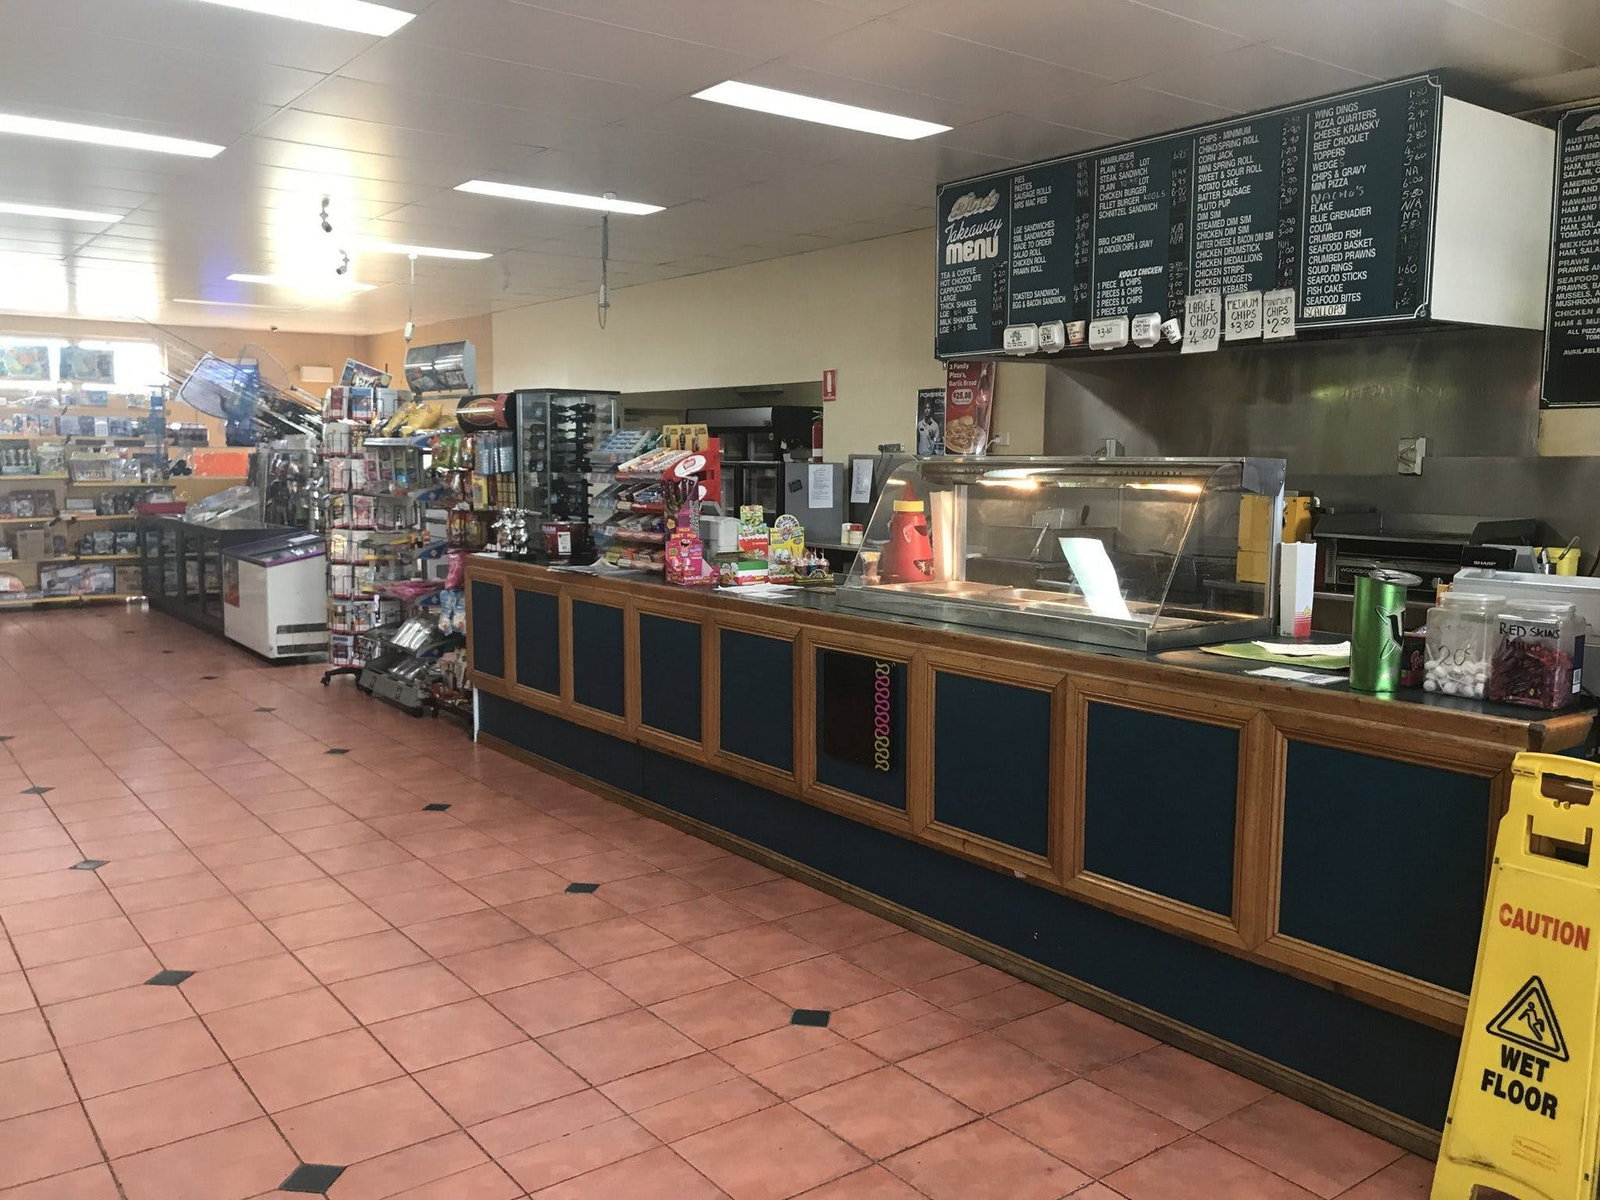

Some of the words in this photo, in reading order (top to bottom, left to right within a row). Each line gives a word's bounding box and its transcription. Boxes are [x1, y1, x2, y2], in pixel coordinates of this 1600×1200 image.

[1315, 108, 1333, 119] WING
[1336, 102, 1358, 113] DINGS
[1315, 118, 1334, 129] PIZZA
[1337, 108, 1376, 124] QUARTERS
[1200, 134, 1217, 144] CHIPS
[1223, 126, 1251, 139] MINIMUM
[1314, 128, 1340, 140] CHEESE
[1343, 119, 1380, 134] KRANSKY
[1199, 144, 1218, 154] CHIKO
[1219, 139, 1241, 149] SPRING
[1242, 135, 1259, 145] ROLL
[1314, 139, 1331, 151] BEEF
[1334, 132, 1370, 147] CROQUET
[1101, 152, 1134, 165] HAMBURGER
[1199, 155, 1216, 164] CORN
[1218, 150, 1233, 159] JACK
[1313, 147, 1345, 160] TOPPERS
[1213, 159, 1235, 170] SPRING
[1238, 156, 1254, 165] ROLL
[1100, 166, 1115, 174] PLAIN
[1100, 174, 1117, 184] STEAK
[1120, 168, 1148, 179] SANDWICH
[1198, 173, 1218, 183] SWEET
[1227, 168, 1244, 177] SOUR
[1246, 164, 1262, 173] ROLL
[1312, 170, 1332, 182] CHIPS
[1342, 165, 1366, 176] GRAVY
[1014, 182, 1032, 192] PASTIES
[1198, 182, 1220, 192] POTATO
[1222, 178, 1238, 188] CAKE
[1328, 178, 1348, 188] PIZZA
[1014, 187, 1035, 200] SAUSAGE
[1036, 186, 1052, 194] ROLLS
[1100, 192, 1123, 201] CHICKEN
[1124, 186, 1146, 196] BURGER
[1198, 192, 1220, 202] BATTER
[1222, 185, 1251, 198] SAUSAGE
[1100, 202, 1116, 210] FILLET
[1117, 197, 1139, 207] BURGER
[1198, 202, 1216, 212] PLUTO
[1218, 199, 1230, 208] PUP
[1311, 201, 1333, 214] FLAKE
[1099, 209, 1126, 219] SCHNITZEL
[1128, 202, 1158, 214] SANDWICH
[1310, 213, 1328, 224] BLUE
[1330, 206, 1372, 221] GRENADIER
[1197, 219, 1225, 231] STEAMED
[1227, 216, 1238, 225] DIM
[1560, 214, 1592, 224] ITALIAN
[945, 218, 1002, 244] Takeaway
[1024, 220, 1055, 233] SANDWICHES
[1309, 223, 1332, 234] COUTA
[1024, 229, 1055, 241] SANDWICHES
[1111, 233, 1135, 244] CHICKEN
[1197, 229, 1222, 240] CHICKEN
[1225, 227, 1236, 236] DIM
[1308, 231, 1343, 244] CRUMBED
[1345, 229, 1362, 239] FISH
[1560, 229, 1590, 239] TOMATO
[1036, 238, 1052, 247] ORDER
[1197, 241, 1213, 250] BATTER
[1214, 238, 1231, 247] CHEESE
[1238, 235, 1254, 243] BACON
[1308, 243, 1342, 255] SEAFOOD
[1344, 238, 1373, 248] BASKET
[1560, 239, 1599, 249] MEXICAN
[946, 236, 998, 265] MENU
[1013, 251, 1028, 259] SALAD
[1104, 245, 1121, 254] CHICKEN
[1196, 249, 1222, 259] CHICKEN
[1224, 244, 1260, 255] DRUMSTICK
[1308, 252, 1342, 264] CRUMBED
[1345, 248, 1376, 260] PRAWNS
[1013, 258, 1033, 267] CHICKEN
[1196, 258, 1222, 268] CHICKEN
[1224, 253, 1262, 265] MEDALLIONS
[1558, 258, 1589, 266] PRAWN
[957, 267, 976, 276] COFFEE
[1013, 267, 1029, 276] PRAWN
[1138, 266, 1163, 276] CHICKEN
[1195, 268, 1221, 278] CHICKEN
[1223, 265, 1244, 275] STRIPS
[1308, 264, 1329, 275] SQUID
[1331, 262, 1353, 272] RINGS
[1558, 265, 1589, 274] PRAWNS
[952, 274, 981, 285] CHOCOLATE
[1102, 281, 1116, 289] PIECE
[1126, 278, 1141, 286] CHIPS
[1195, 278, 1221, 287] CHICKEN
[1223, 274, 1252, 285] NUGGETS
[1307, 274, 1340, 285] SEAFOOD
[1342, 271, 1367, 281] STICKS
[1557, 274, 1598, 284] SEAFOOD
[940, 284, 971, 294] CAPPUCCINO
[1013, 292, 1032, 300] TOASTED
[1034, 288, 1059, 298] SANDWICH
[1102, 289, 1119, 298] PIECES
[1126, 286, 1142, 294] CHIPS
[1223, 284, 1248, 294] KEBABS
[1307, 285, 1322, 295] FISH
[1324, 284, 1343, 293] CAKE
[956, 299, 976, 308] SHAKES
[1043, 296, 1066, 305] SANDWICH
[1101, 298, 1119, 306] PIECES
[1126, 296, 1142, 304] CHIPS
[1227, 298, 1258, 310] MEDIUM
[1306, 295, 1338, 306] SEAFOOD
[1340, 293, 1361, 302] BITES
[1101, 308, 1116, 316] PIECE
[1188, 299, 1215, 314] LARGE
[1267, 306, 1288, 317] CHIPS
[1555, 308, 1593, 317] CHICKEN
[1190, 312, 1218, 327] CHIPS
[1231, 309, 1256, 320] CHIPS
[1500, 621, 1526, 637] RED
[1530, 624, 1560, 639] SKINS
[1499, 902, 1590, 951] CAUTION
[1500, 1044, 1550, 1082] WET
[1480, 1068, 1558, 1120] FLOOR
